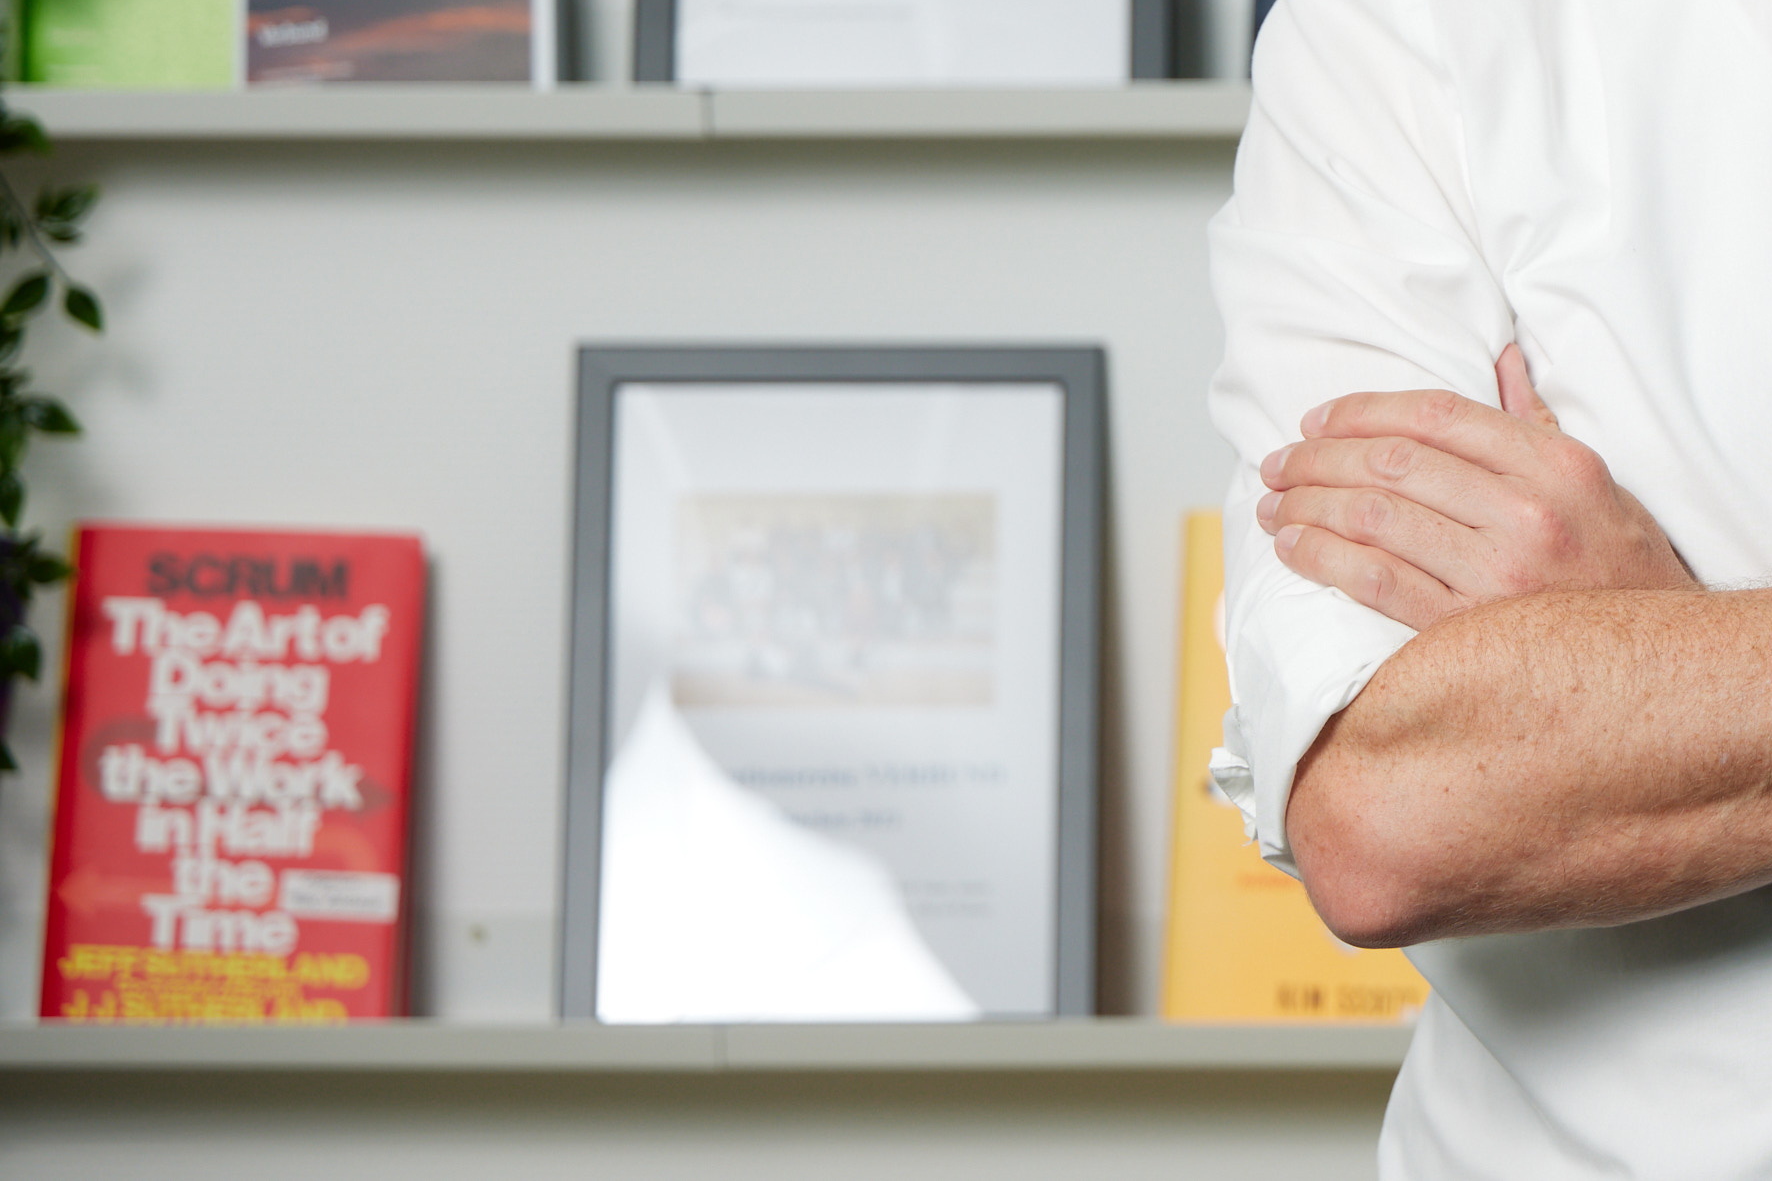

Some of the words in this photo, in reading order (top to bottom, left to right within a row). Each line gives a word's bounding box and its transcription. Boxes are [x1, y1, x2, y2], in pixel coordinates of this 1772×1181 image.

[147, 551, 350, 602] SCRUM
[104, 596, 222, 656] The
[223, 600, 322, 659] Art
[325, 603, 391, 662] of
[150, 651, 330, 715] Doing
[147, 696, 328, 758] Twice
[100, 744, 201, 802] the
[204, 748, 364, 811] Work
[135, 795, 191, 852] in
[203, 798, 322, 858] Half
[172, 846, 276, 908] the
[141, 892, 301, 955] Time
